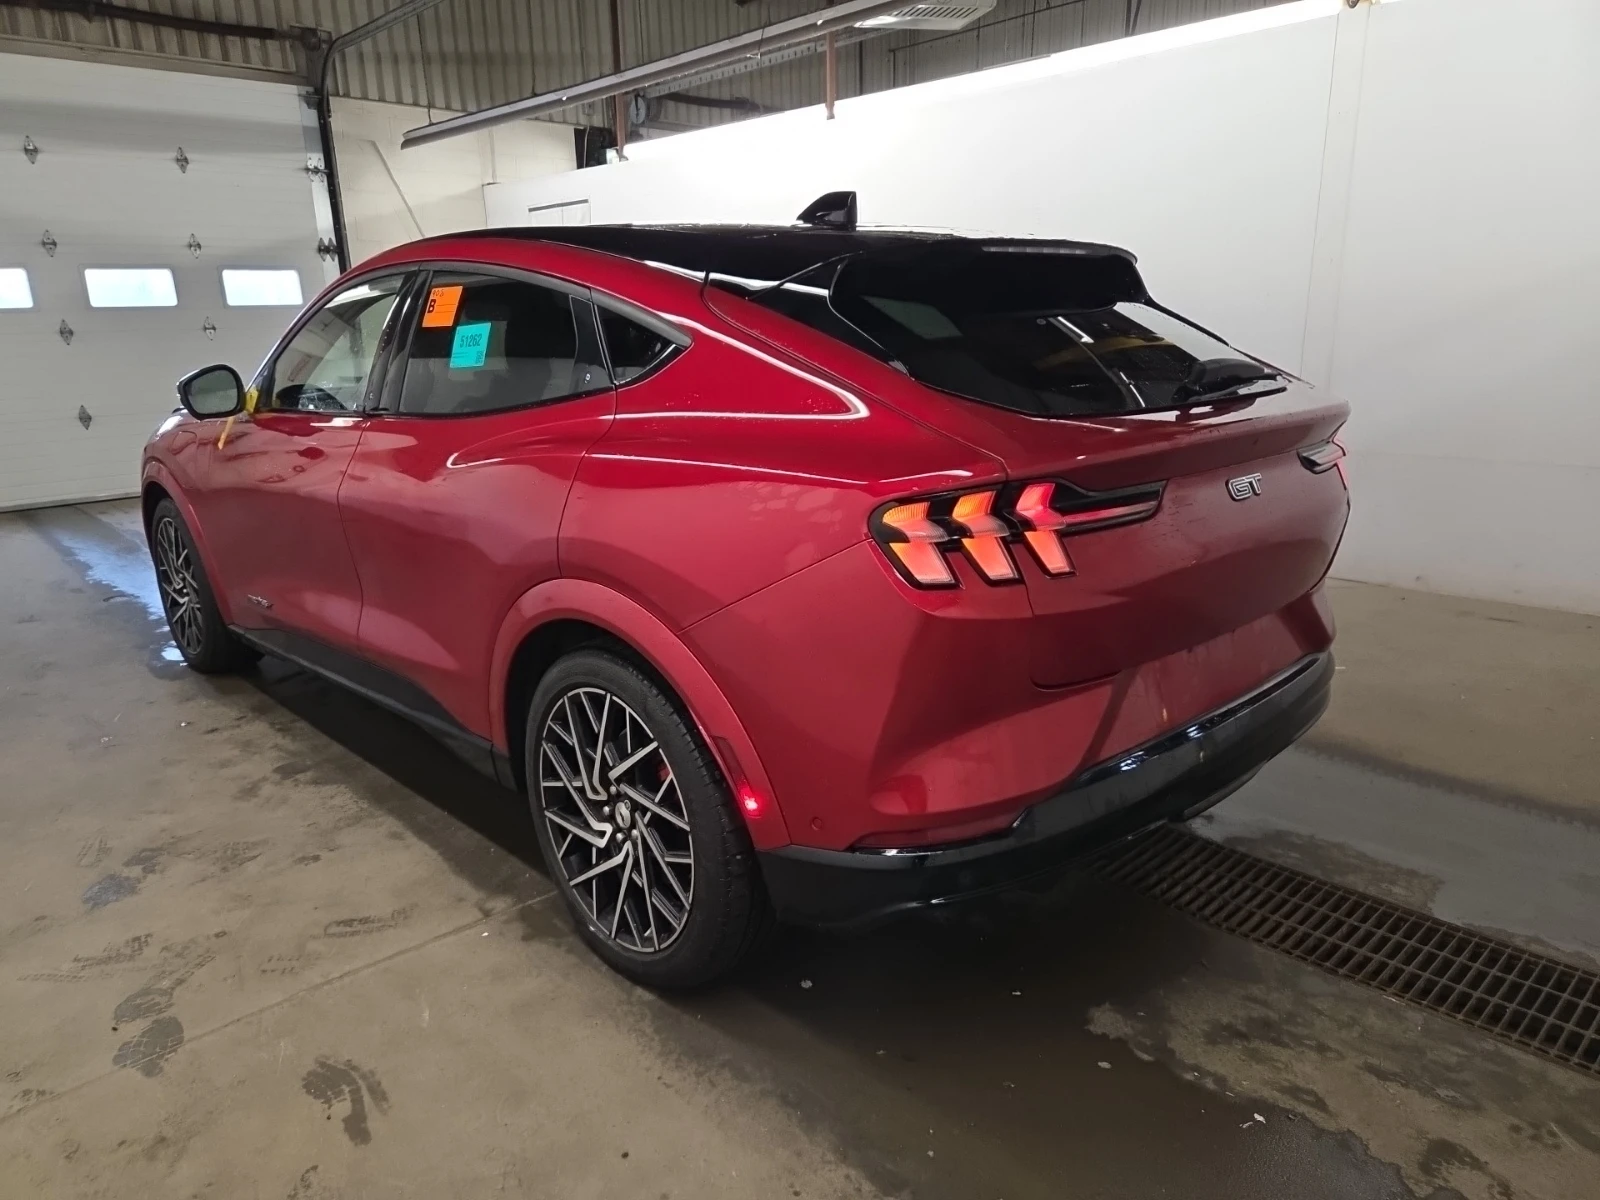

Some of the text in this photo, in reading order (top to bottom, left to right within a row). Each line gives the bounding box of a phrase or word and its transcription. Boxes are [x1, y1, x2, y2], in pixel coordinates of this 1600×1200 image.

[427, 298, 437, 313] B
[459, 333, 483, 348] 51262
[1227, 472, 1262, 501] GT
